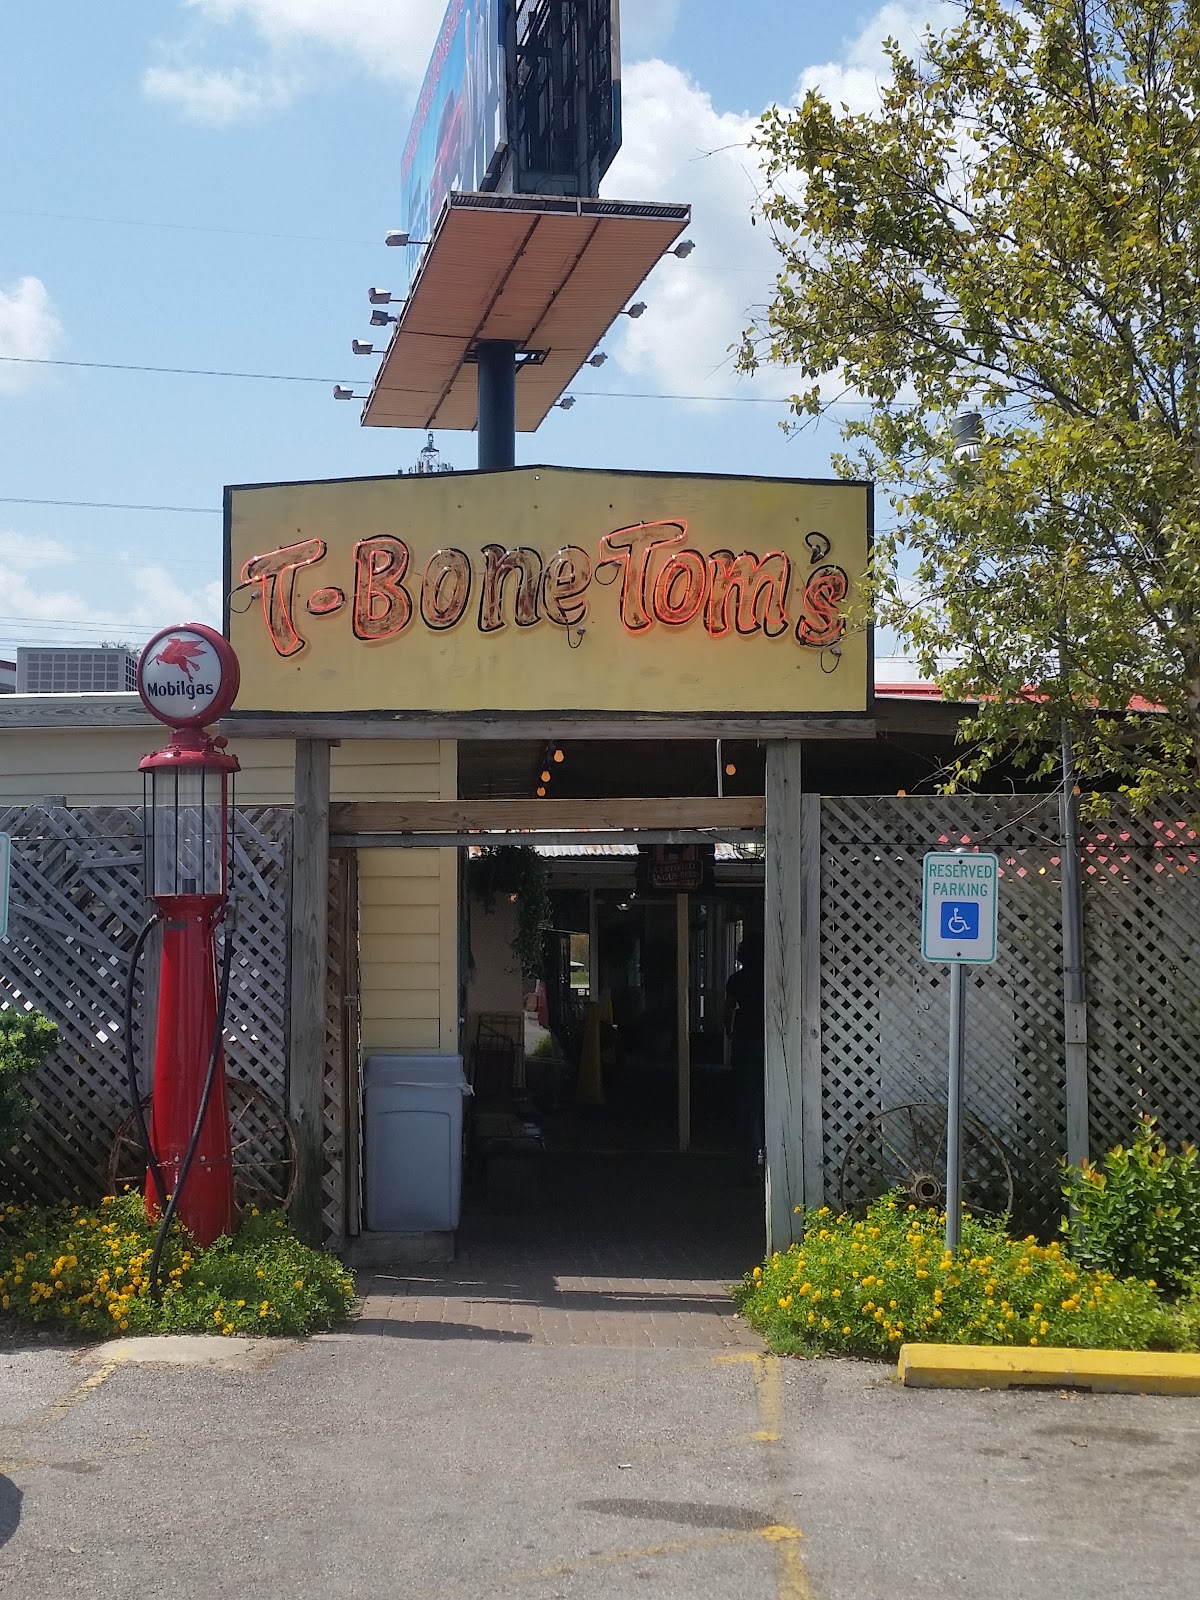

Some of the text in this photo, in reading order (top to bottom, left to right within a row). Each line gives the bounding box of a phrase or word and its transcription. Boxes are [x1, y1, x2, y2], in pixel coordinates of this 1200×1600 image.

[241, 518, 848, 657] T-Bone Tom's
[147, 680, 214, 700] Mobilgas
[929, 864, 992, 879] RESERVED
[933, 882, 988, 897] PARKING
